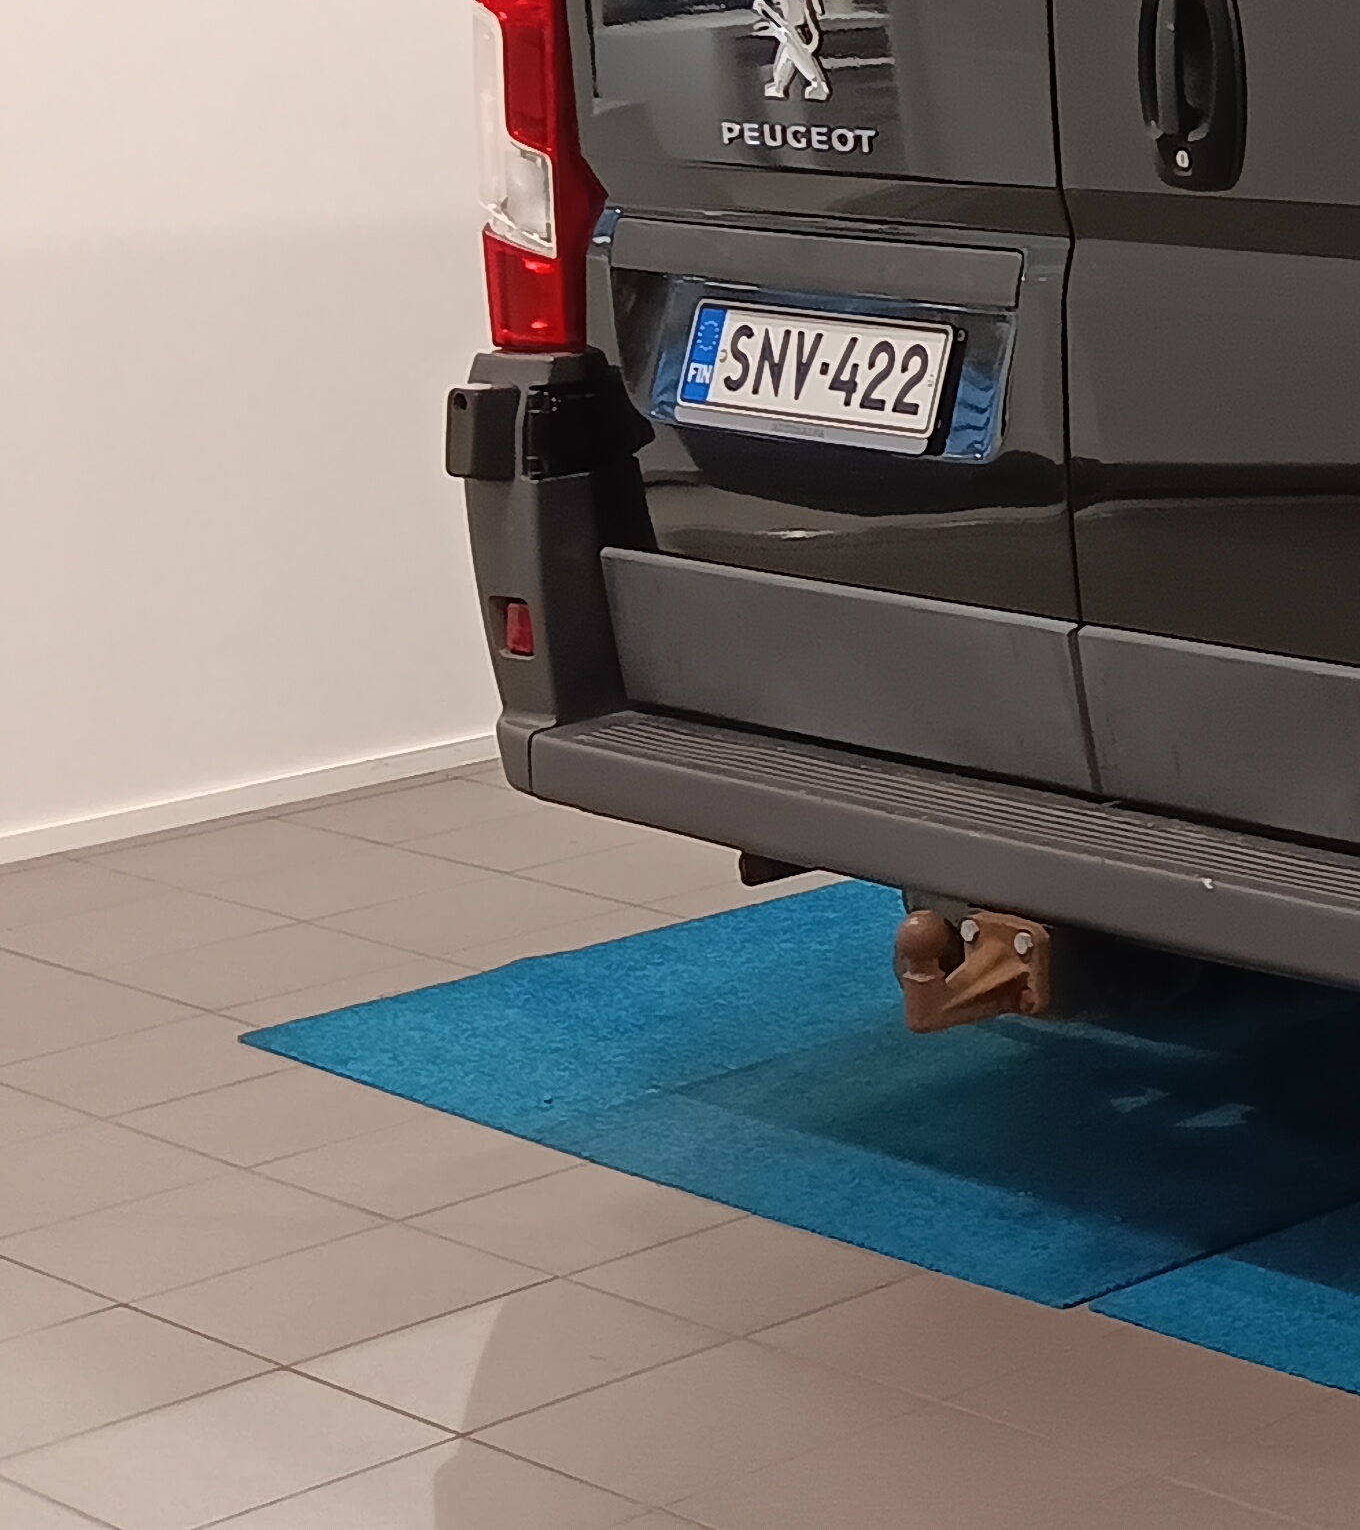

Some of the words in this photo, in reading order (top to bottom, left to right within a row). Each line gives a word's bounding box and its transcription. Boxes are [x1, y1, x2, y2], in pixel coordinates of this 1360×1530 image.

[720, 121, 877, 154] PEUGEOT
[687, 362, 713, 385] FIN
[723, 324, 929, 416] SNV-422
